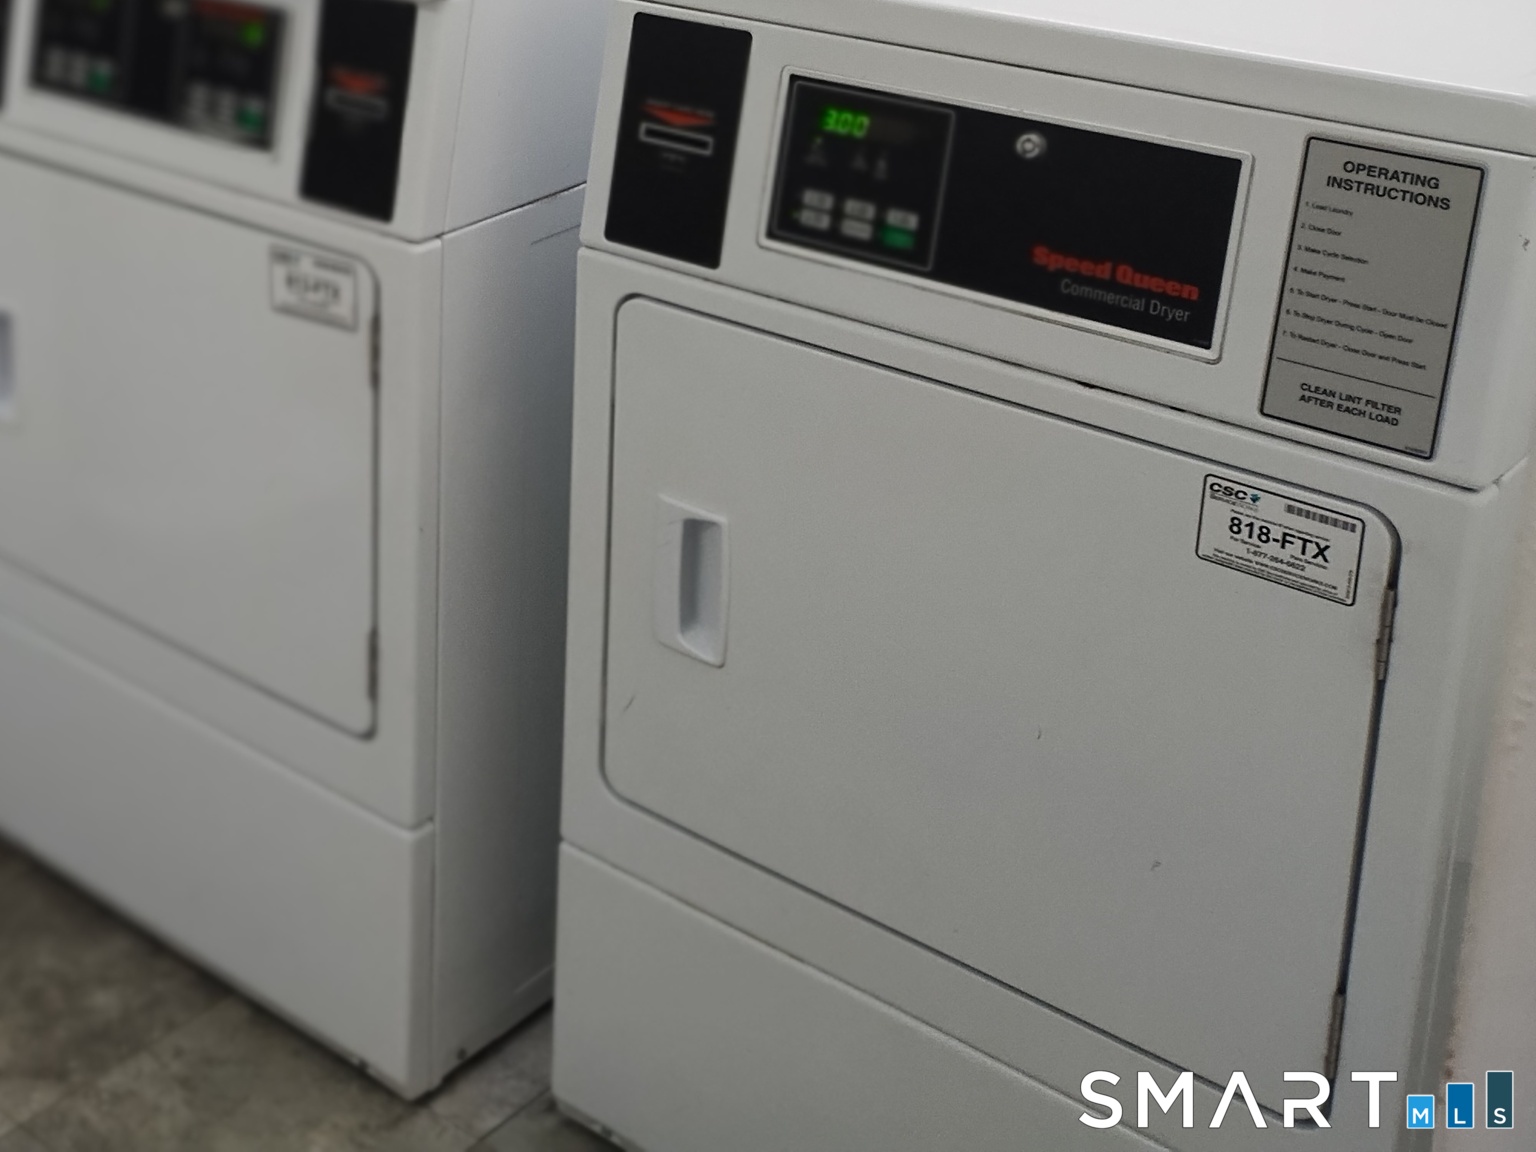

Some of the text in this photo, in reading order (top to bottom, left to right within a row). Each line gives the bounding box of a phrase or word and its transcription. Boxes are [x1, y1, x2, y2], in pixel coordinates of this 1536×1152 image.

[1343, 160, 1440, 189] OPERATING
[1326, 175, 1451, 210] INSTRUCTIONS
[1031, 244, 1201, 302] Speed Queen
[1060, 278, 1191, 323] Commercial Dryer
[1298, 394, 1399, 427] AFTER EACH LOAD
[1300, 382, 1402, 416] CLEAN LINT FILTER
[1209, 482, 1248, 500] CSC
[1228, 516, 1331, 564] 818-FTX
